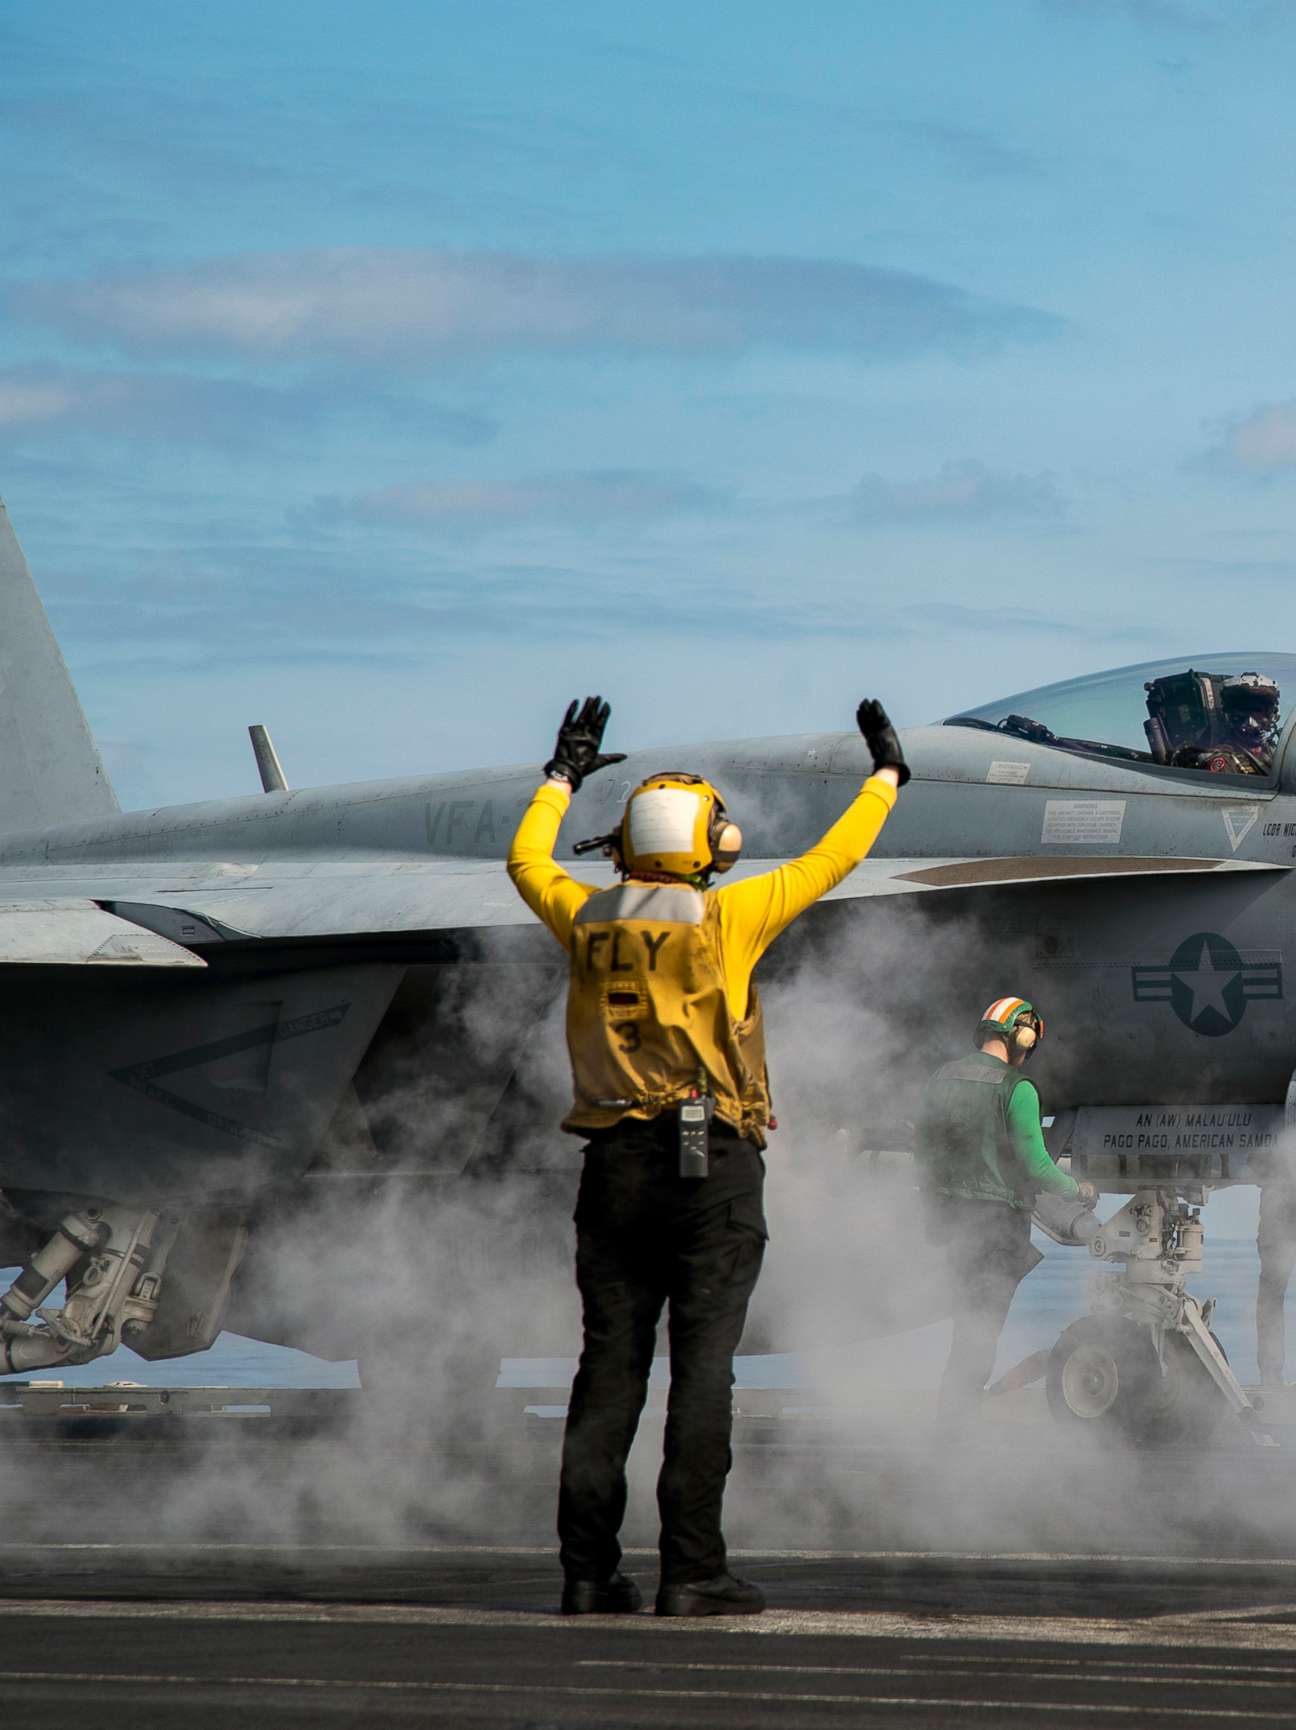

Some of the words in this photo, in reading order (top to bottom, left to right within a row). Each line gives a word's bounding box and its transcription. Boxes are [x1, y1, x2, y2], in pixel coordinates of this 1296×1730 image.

[425, 799, 531, 845] VFA-
[586, 927, 672, 972] FLY
[614, 1021, 643, 1054] 3
[1136, 1112, 1153, 1127] AN
[1156, 1112, 1181, 1128] (AW)
[1103, 1133, 1133, 1149] PAGO
[1136, 1133, 1170, 1150] PAGO,
[1174, 1133, 1233, 1149] AMERICAN
